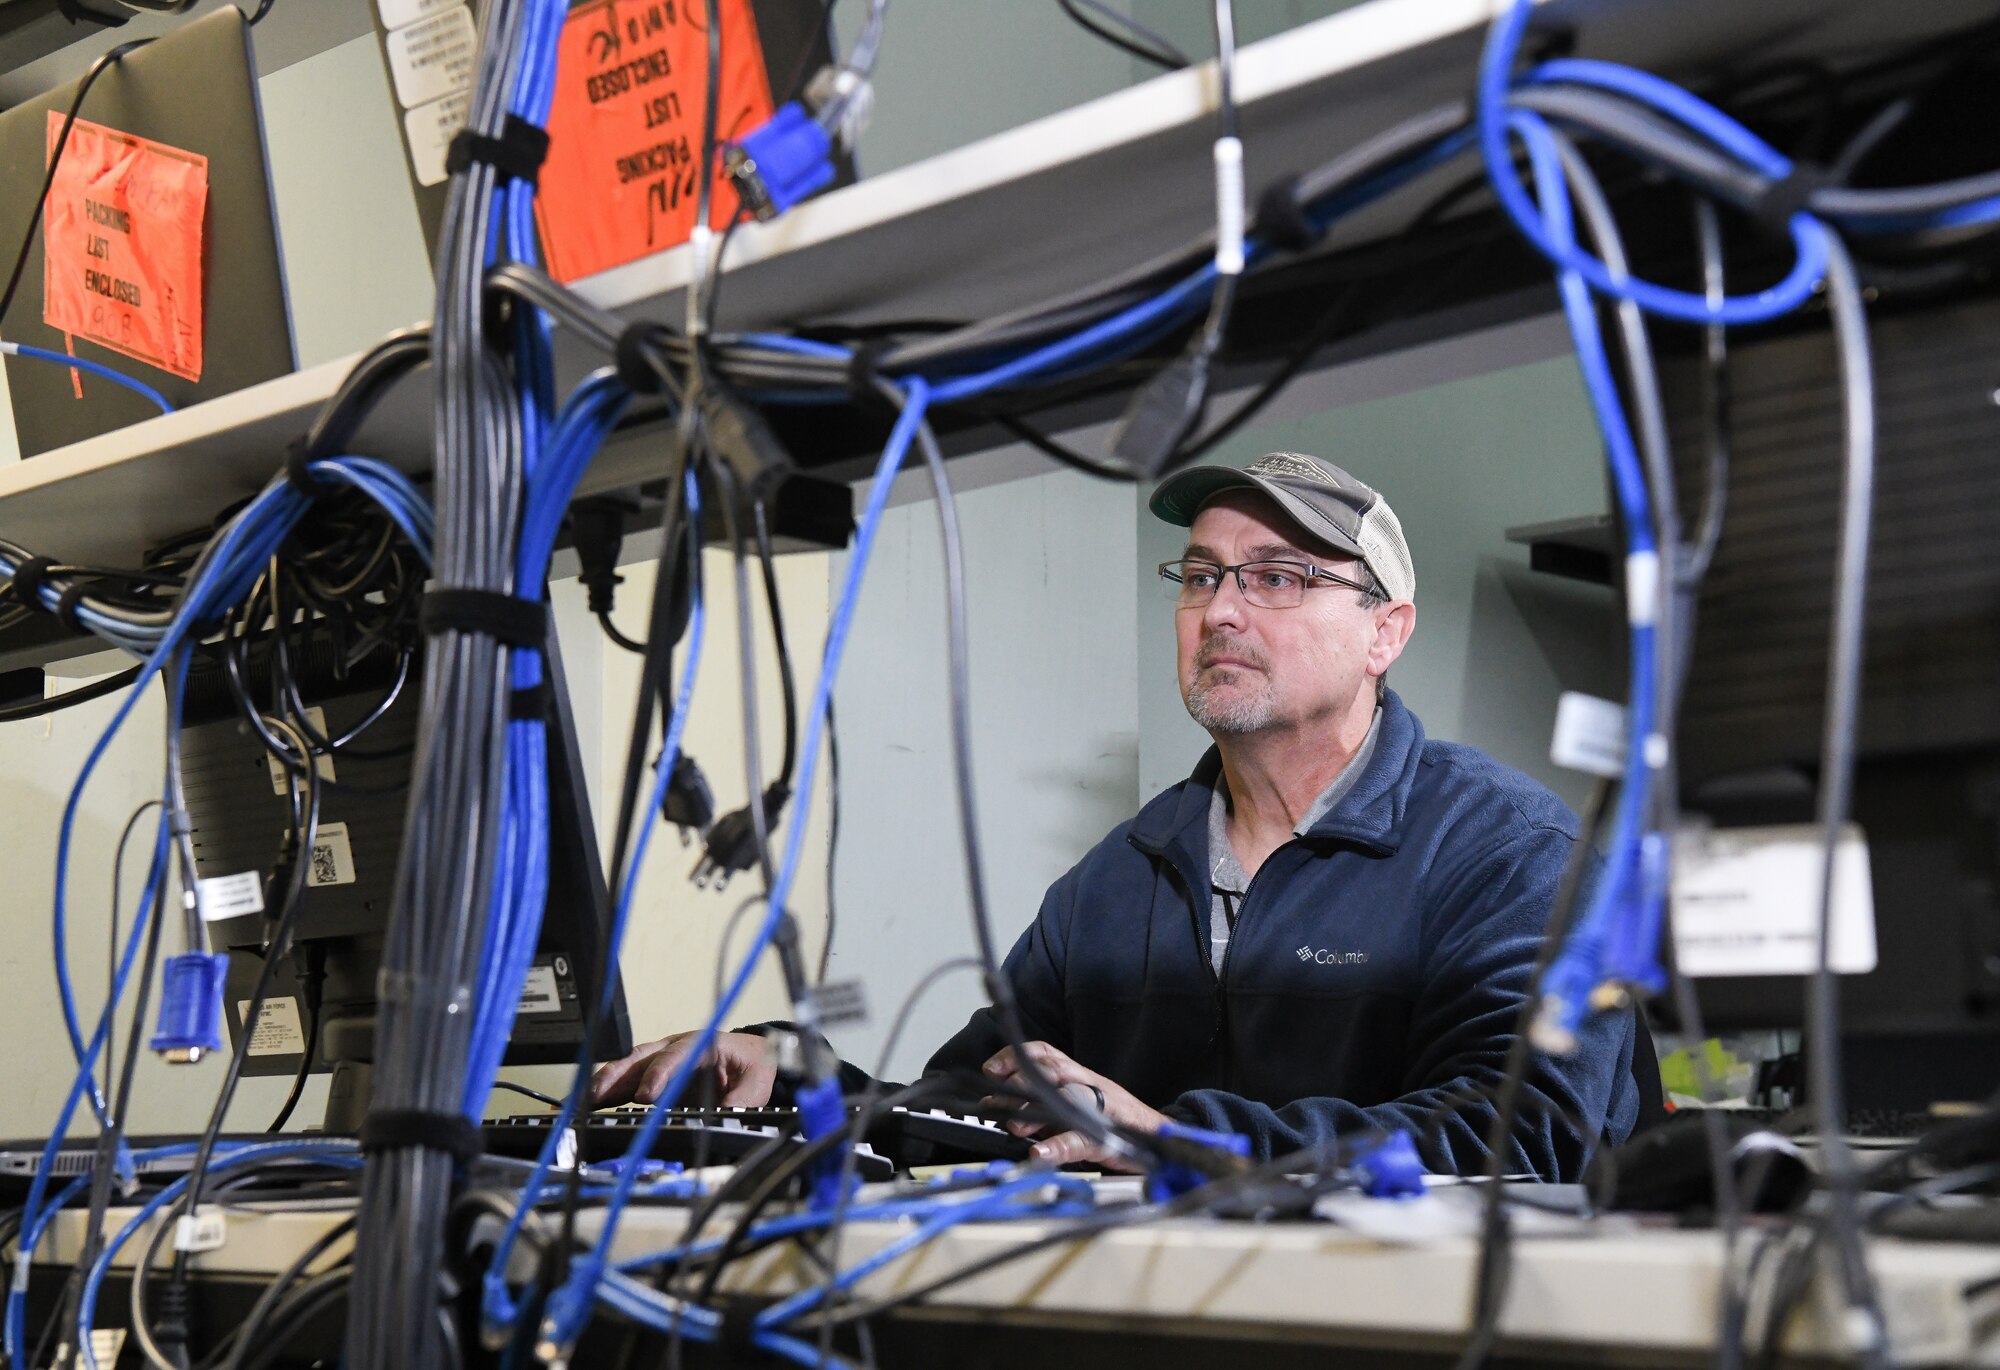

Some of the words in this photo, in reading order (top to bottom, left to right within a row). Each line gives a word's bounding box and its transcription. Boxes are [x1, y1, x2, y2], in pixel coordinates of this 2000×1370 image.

[587, 49, 671, 103] ENCLOSED
[644, 92, 681, 130] LIST
[616, 135, 690, 184] PACKING
[86, 199, 130, 234] PACKING
[87, 234, 109, 260] LIST
[85, 269, 141, 307] ENCLOSED
